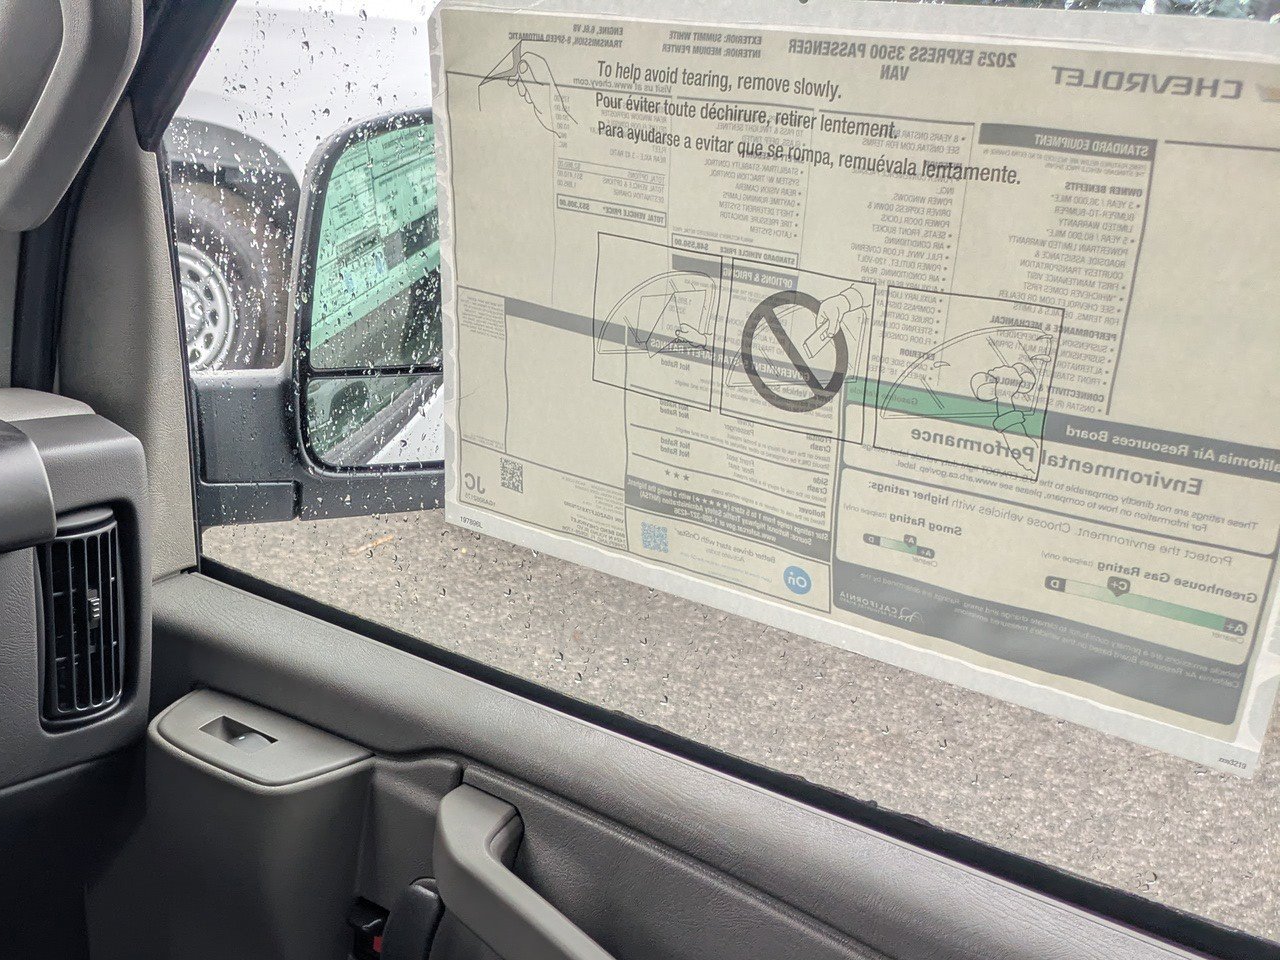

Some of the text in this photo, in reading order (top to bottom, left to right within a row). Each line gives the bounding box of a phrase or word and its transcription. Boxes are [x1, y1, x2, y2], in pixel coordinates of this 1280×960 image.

[598, 60, 841, 102] To help avoid tearing, remove slowly.
[596, 92, 622, 109] Pour
[626, 94, 660, 113] éviter
[664, 100, 696, 118] toute
[701, 102, 770, 127] déchirure,
[775, 110, 816, 130] retirer
[820, 114, 898, 139] lentement.
[598, 121, 624, 138] Para
[627, 127, 680, 147] ayudarse
[684, 136, 691, 148] a
[696, 135, 734, 153] evitar
[738, 141, 763, 159] que
[767, 144, 783, 158] se
[788, 147, 834, 168] rompa,
[839, 153, 916, 176] remuévala
[921, 159, 1020, 185] lentamente.
